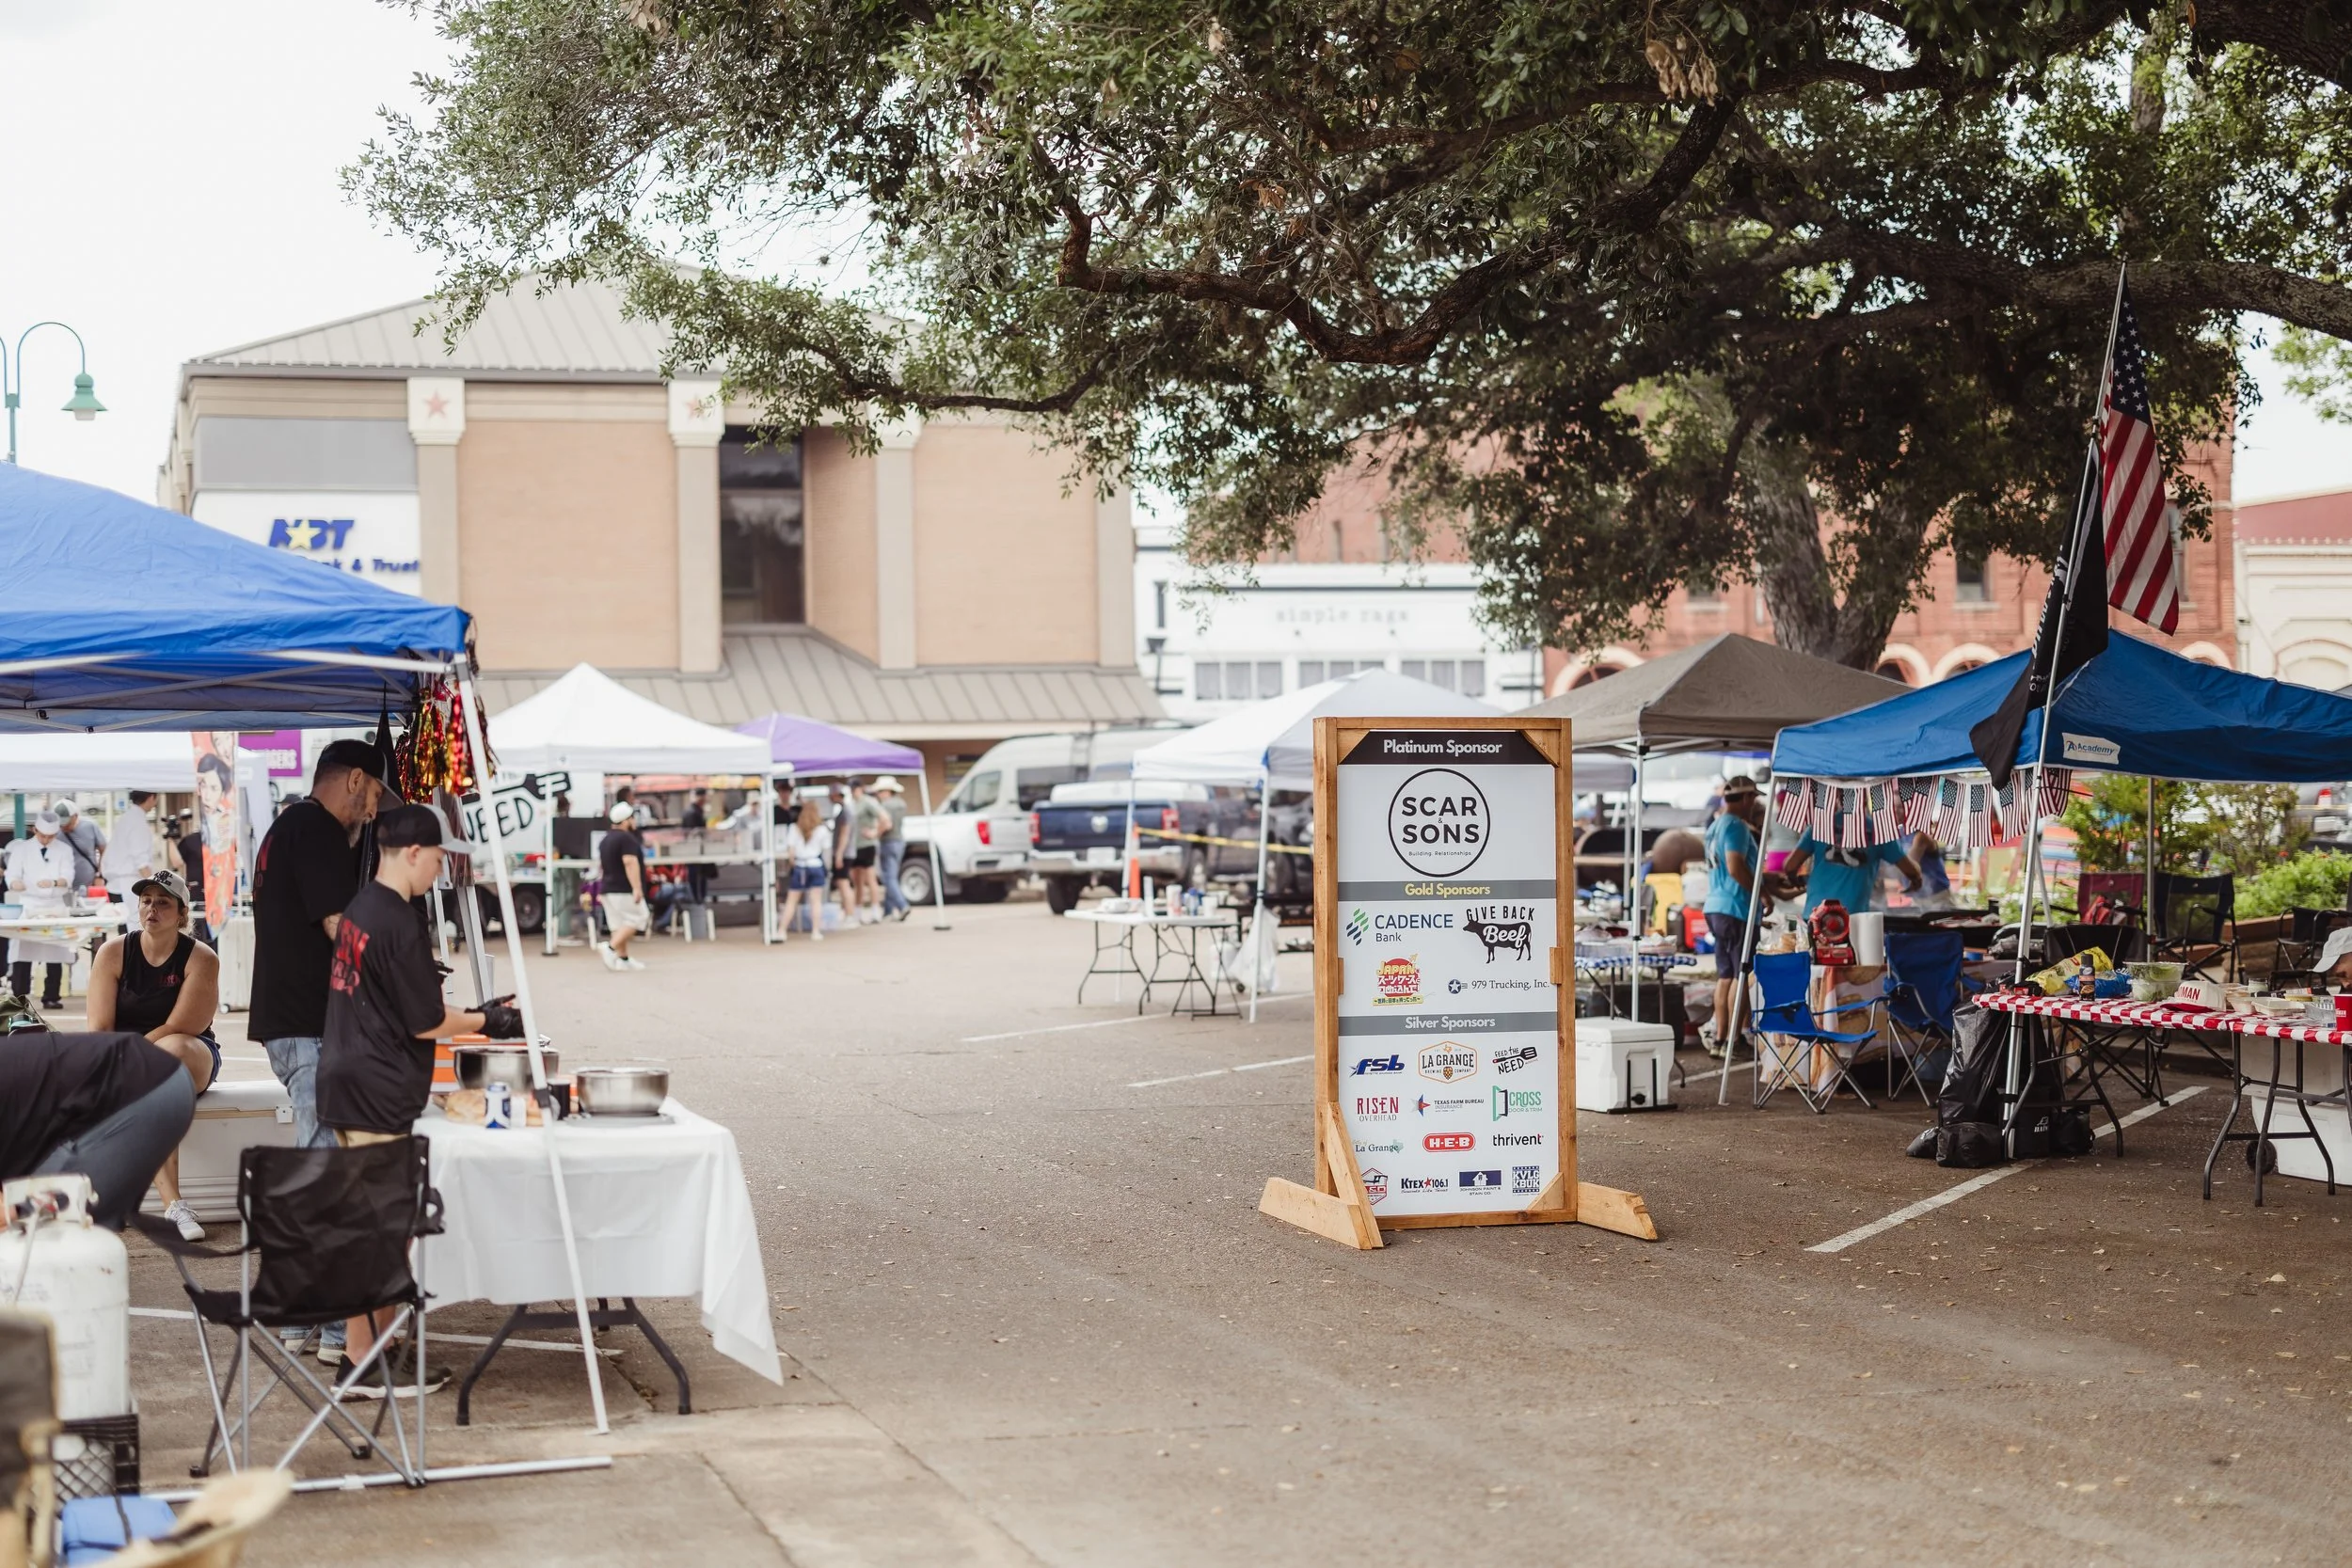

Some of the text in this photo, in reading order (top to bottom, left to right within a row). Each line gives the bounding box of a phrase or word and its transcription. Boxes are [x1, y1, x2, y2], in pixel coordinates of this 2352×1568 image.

[373, 559, 421, 571] Trust
[1383, 739, 1502, 756] Platinum Sponsor
[2077, 742, 2115, 756] Academy
[1401, 797, 1478, 816] SCAR
[1402, 824, 1480, 844] SONS
[1405, 883, 1491, 898] Gold Sponsors
[1375, 914, 1454, 929] CADENCE
[1466, 906, 1535, 923] GIVE BACK
[1375, 932, 1402, 942] Bank
[1482, 925, 1527, 948] Beef
[1471, 979, 1549, 990] 979 Trucking, Inc.
[1405, 1016, 1496, 1031] Silver Sponsors
[1422, 1053, 1474, 1069] LA GRANGE
[1494, 1050, 1508, 1058] FEED
[1357, 1054, 1406, 1075] fsb
[1498, 1058, 1524, 1075] NEED
[1357, 1097, 1399, 1115] RISEN
[1509, 1091, 1542, 1107] CROSS
[1493, 1133, 1542, 1147] thrivent
[1356, 1143, 1399, 1153] La Grange
[1513, 1170, 1539, 1180] KVLG
[1431, 1179, 1449, 1188] 106.1
